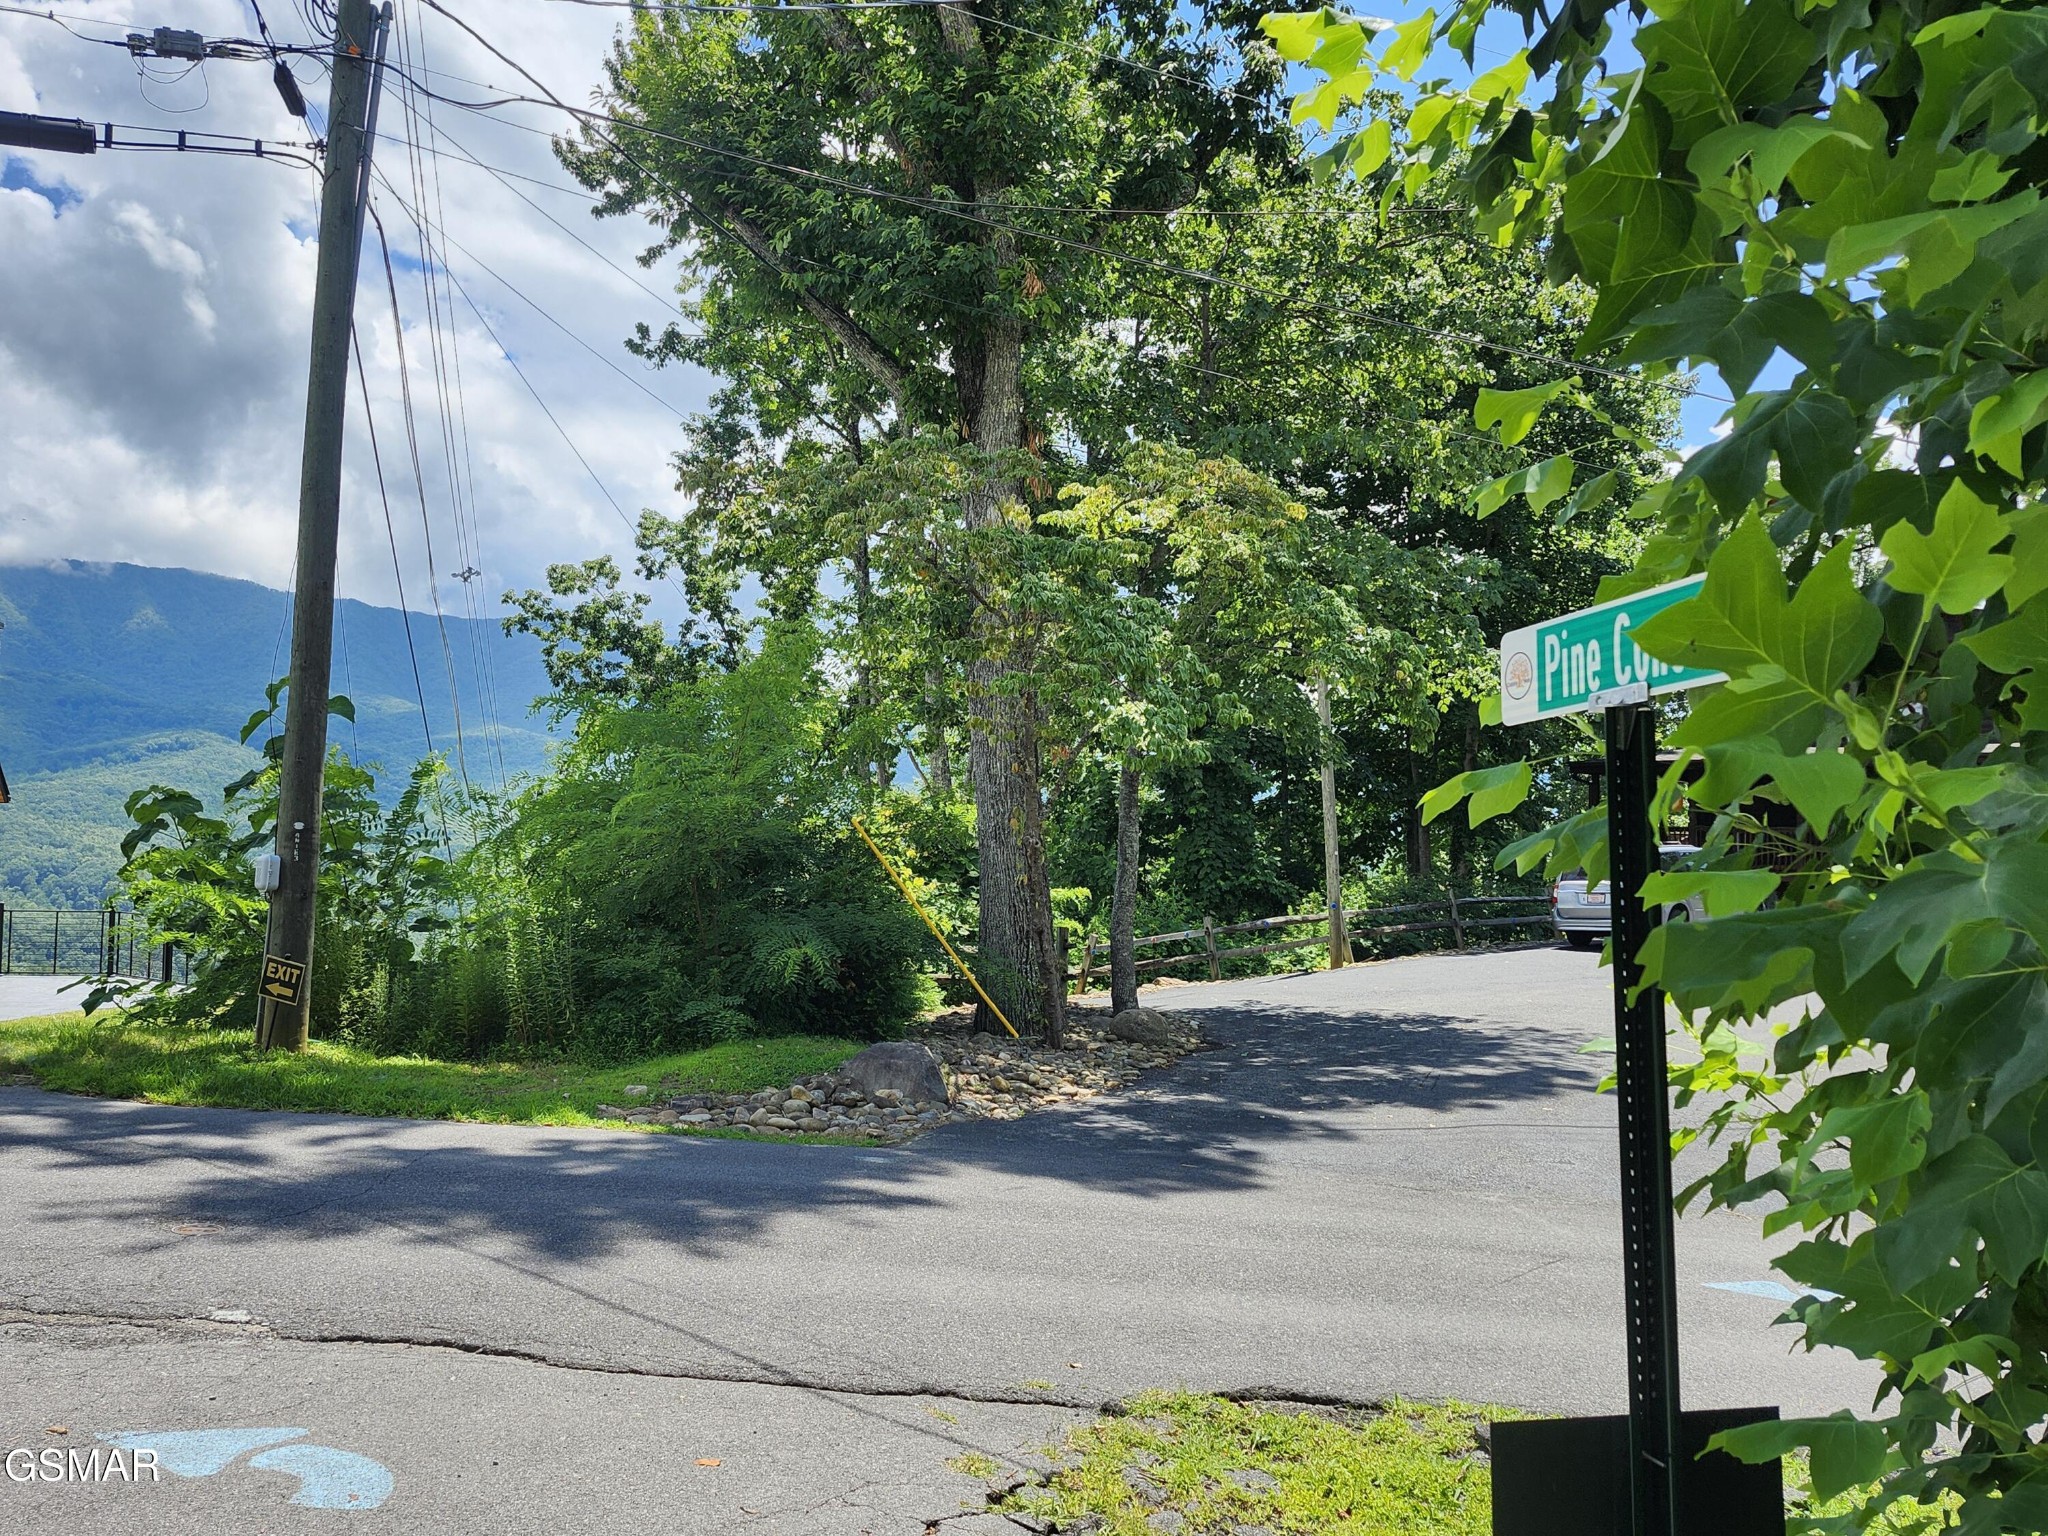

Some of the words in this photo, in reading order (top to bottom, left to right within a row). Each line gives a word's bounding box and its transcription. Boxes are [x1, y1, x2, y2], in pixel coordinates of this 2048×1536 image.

[1544, 629, 1601, 702] Pine
[1613, 612, 1685, 686] Co
[266, 961, 301, 984] EXIT
